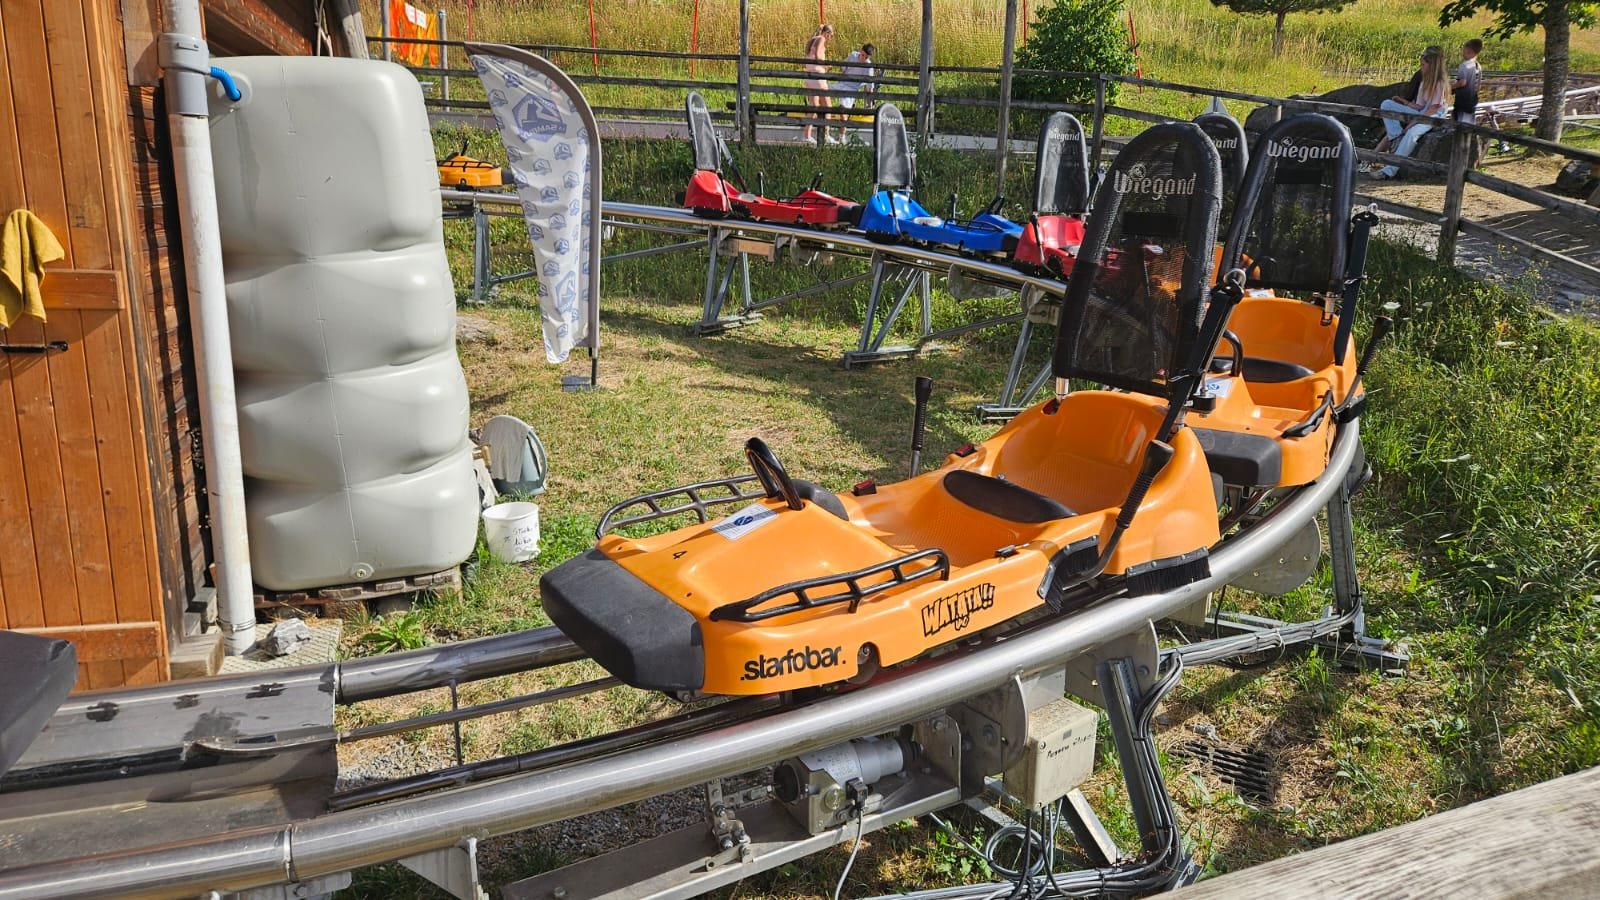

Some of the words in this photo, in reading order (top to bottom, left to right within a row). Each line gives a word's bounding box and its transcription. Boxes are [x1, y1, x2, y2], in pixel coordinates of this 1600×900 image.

[1266, 138, 1343, 163] Wiegand
[1113, 167, 1197, 201] Wiegand
[672, 550, 688, 560] 4
